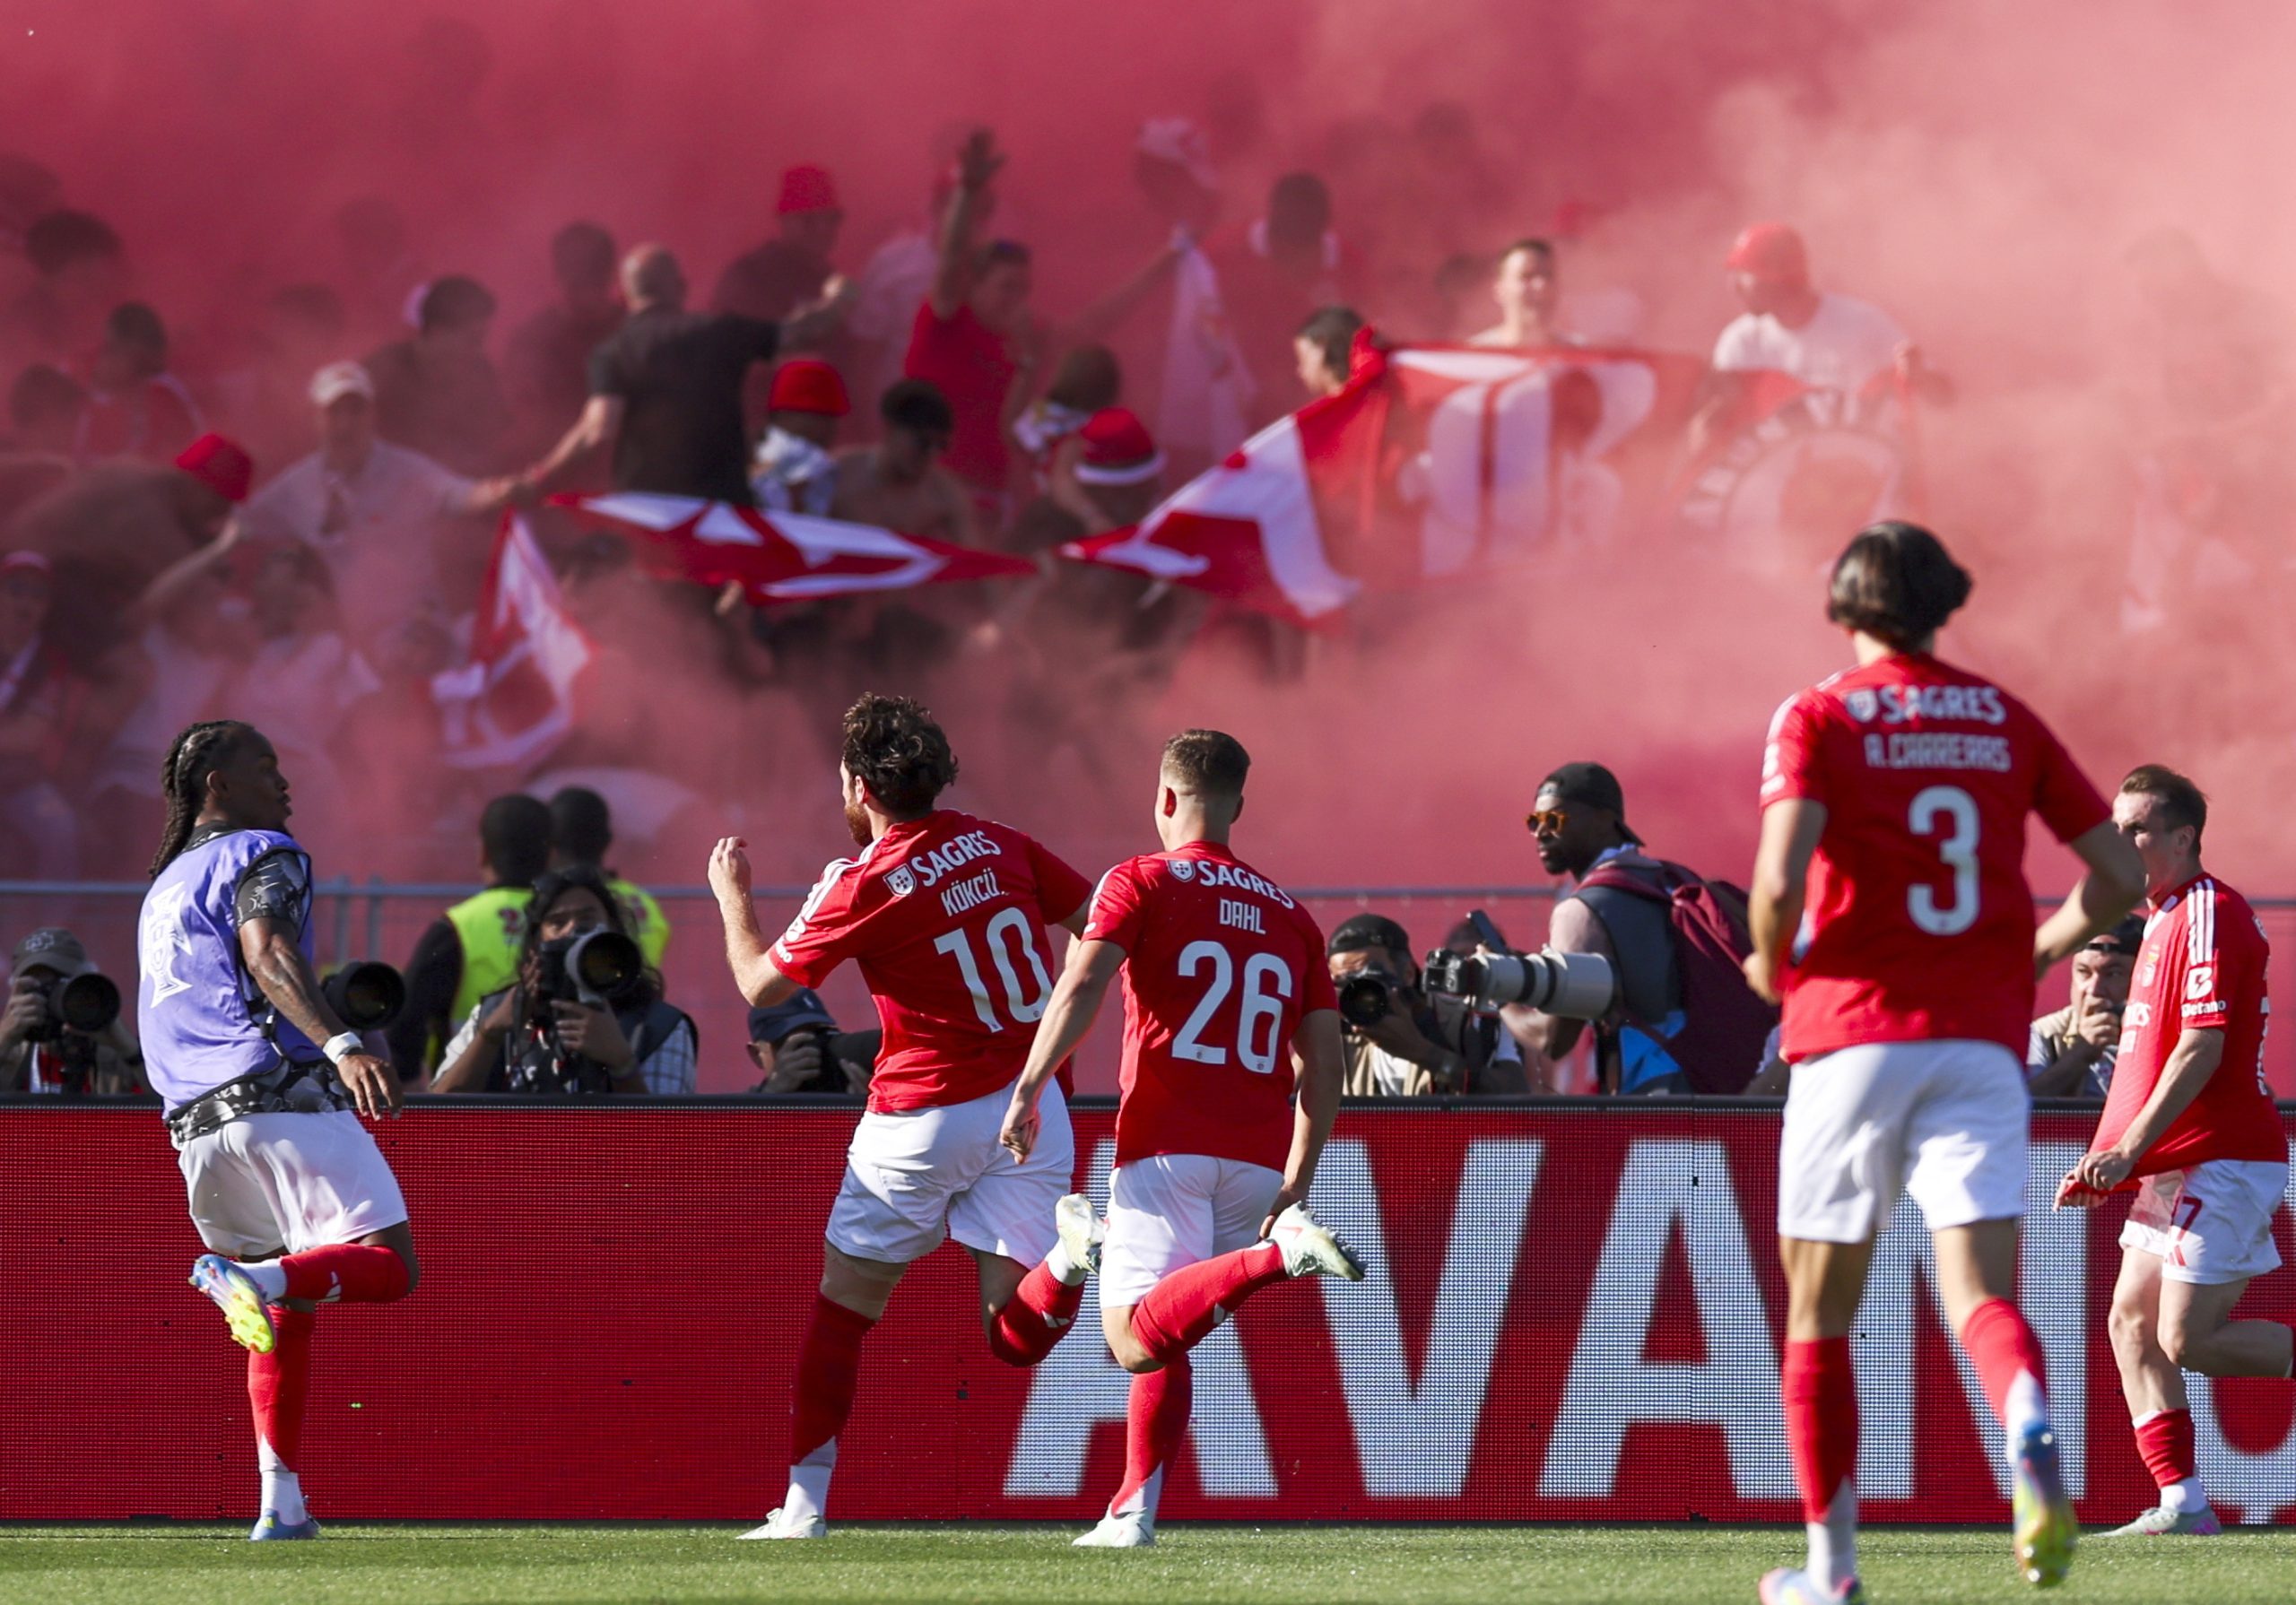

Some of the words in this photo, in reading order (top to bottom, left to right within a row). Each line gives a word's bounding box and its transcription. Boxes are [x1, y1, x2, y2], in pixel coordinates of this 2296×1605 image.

[1879, 685, 2006, 724] SAGRES
[911, 830, 1001, 887] SAGRES
[1197, 860, 1294, 909] SAGRES
[1908, 785, 1980, 935] 3
[1220, 898, 1266, 934] DAHL
[934, 907, 1054, 1034] 10
[1171, 940, 1292, 1074] 26
[2180, 1000, 2226, 1018] Betano
